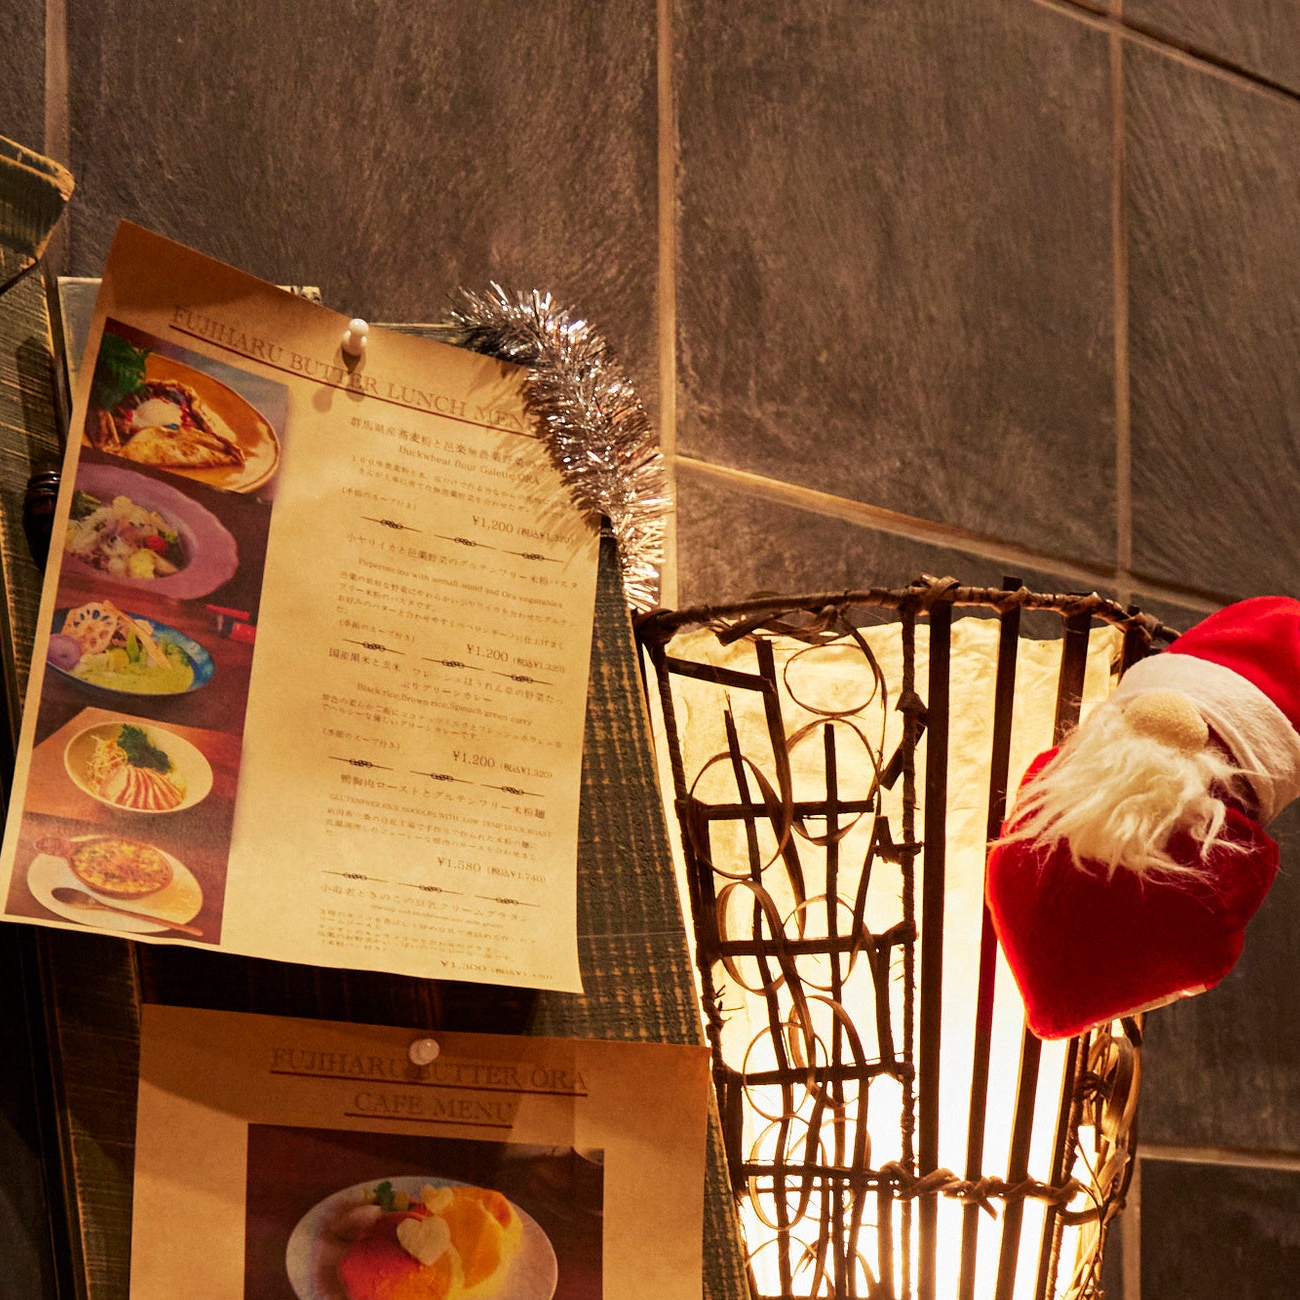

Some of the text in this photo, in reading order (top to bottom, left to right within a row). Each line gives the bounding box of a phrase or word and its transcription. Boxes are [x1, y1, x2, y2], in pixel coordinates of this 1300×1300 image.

[172, 305, 536, 432] FUJIHARU BUTTER LUNCH MEN
[399, 445, 451, 465] Buckwheat
[454, 459, 477, 471] flour
[472, 515, 514, 534] ¥1,200
[466, 643, 509, 663] ¥1,200
[452, 750, 496, 769] ¥1,200
[270, 1048, 404, 1079] FUJIHARU
[433, 1097, 514, 1123] MENU
